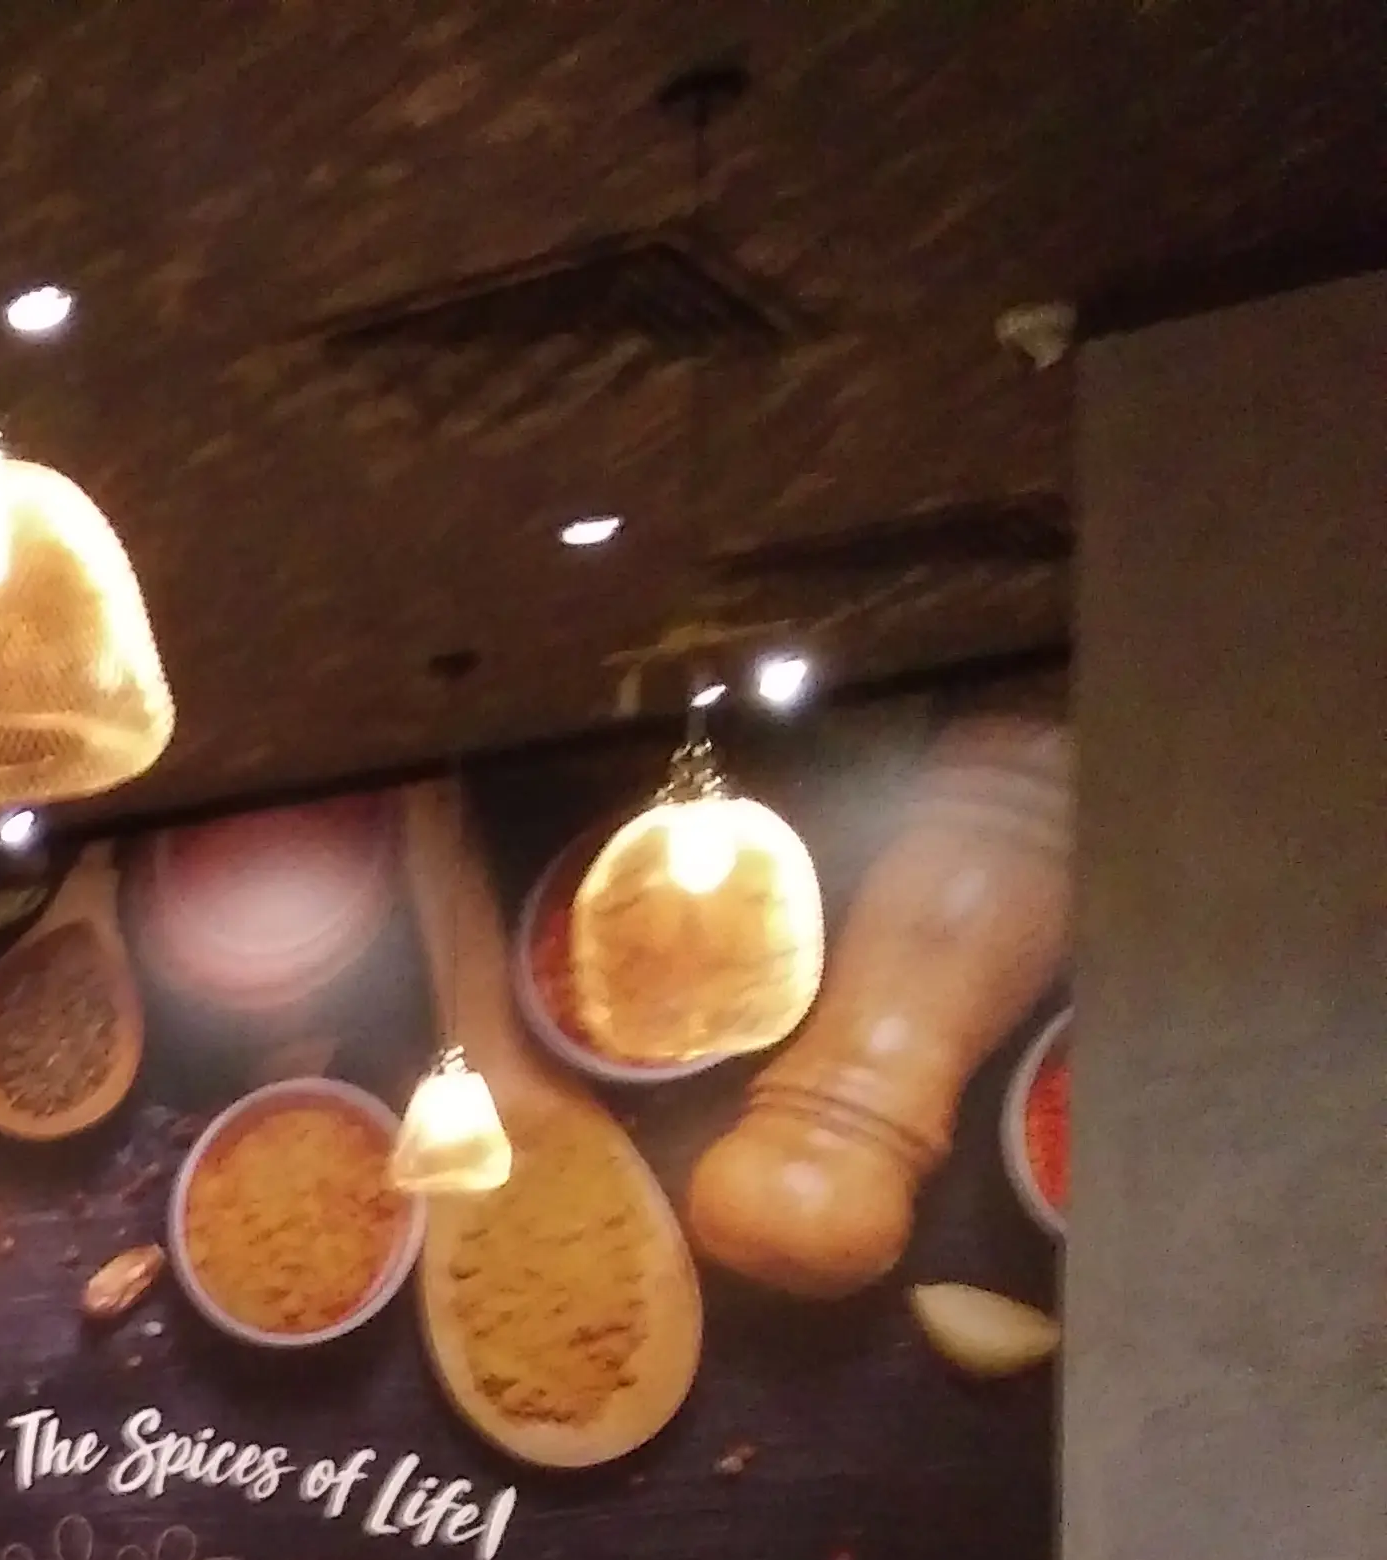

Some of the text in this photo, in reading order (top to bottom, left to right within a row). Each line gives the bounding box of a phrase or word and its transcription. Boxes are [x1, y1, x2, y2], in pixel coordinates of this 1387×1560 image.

[5, 1406, 109, 1491] The
[107, 1406, 297, 1499] Spices
[299, 1446, 377, 1518] of
